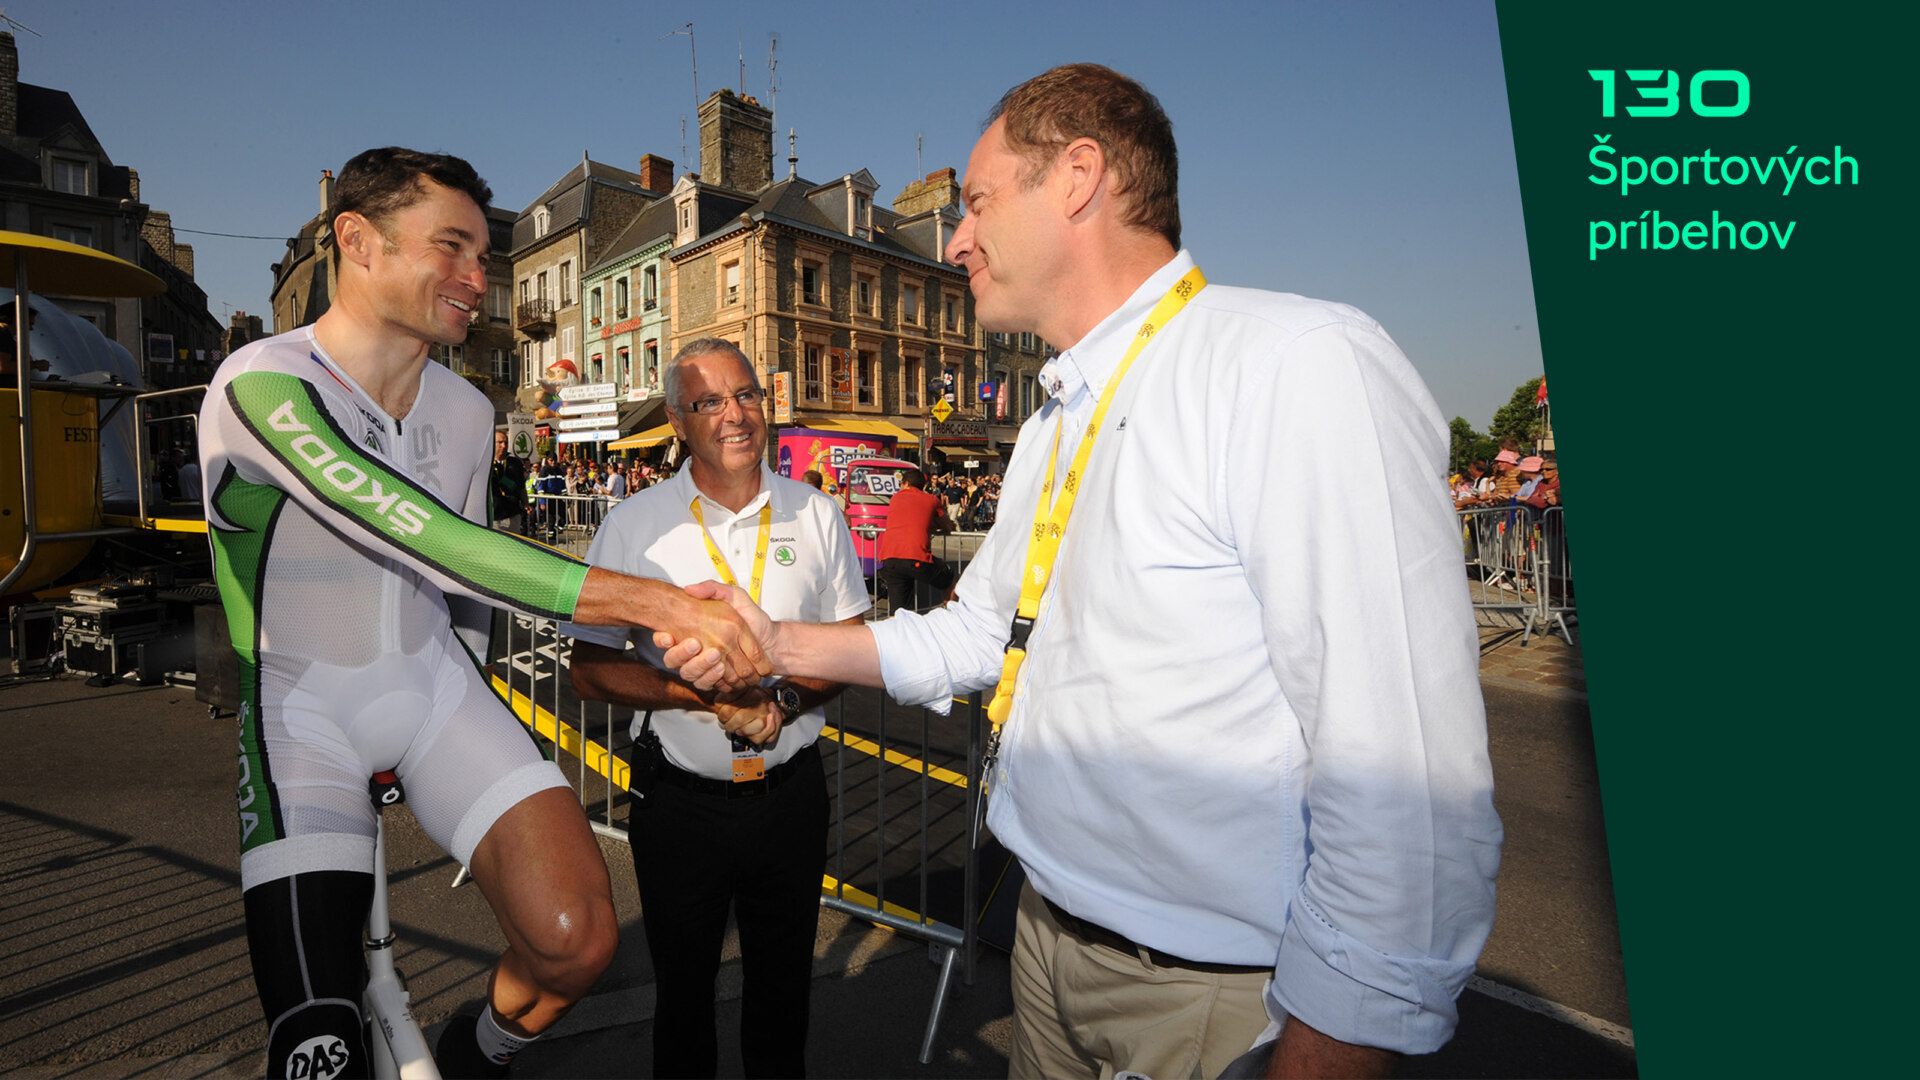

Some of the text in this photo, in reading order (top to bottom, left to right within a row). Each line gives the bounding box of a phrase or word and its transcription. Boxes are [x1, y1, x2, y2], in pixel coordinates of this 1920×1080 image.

[996, 385, 1005, 416] TABAC
[933, 422, 987, 435] TABAC-CADEAUX
[267, 400, 432, 537] ŠKODA
[291, 1040, 348, 1080] DAS
